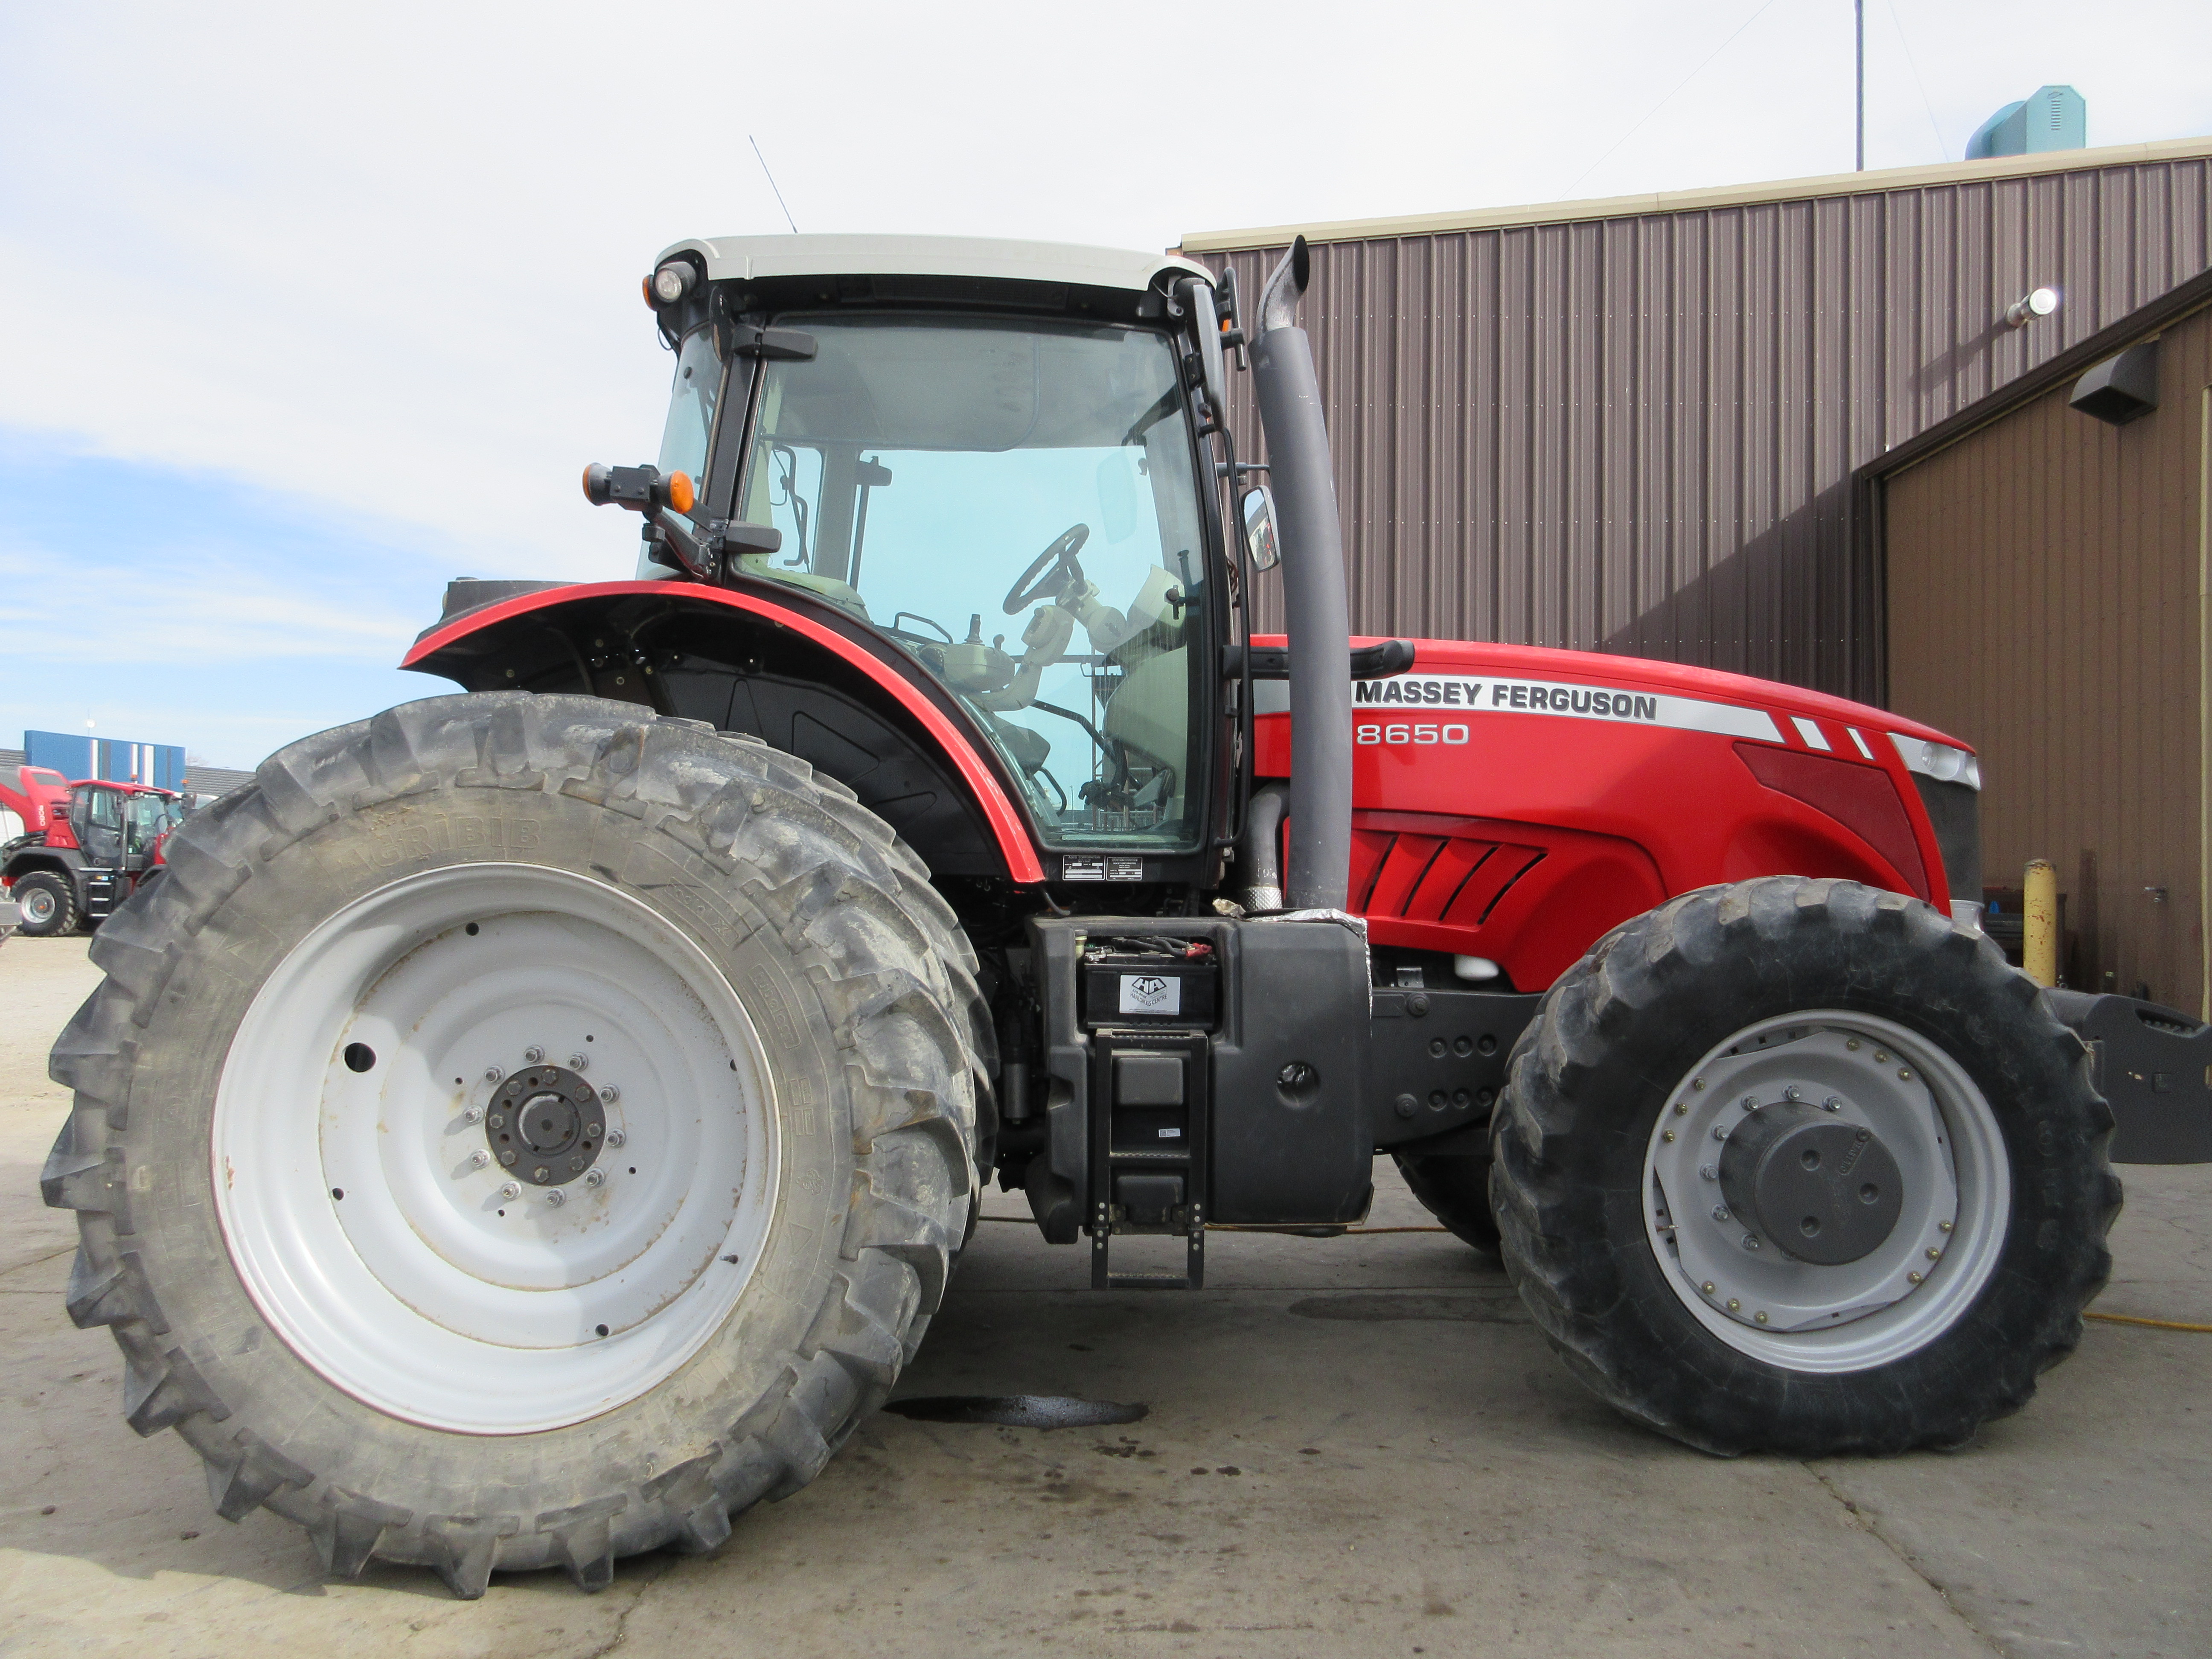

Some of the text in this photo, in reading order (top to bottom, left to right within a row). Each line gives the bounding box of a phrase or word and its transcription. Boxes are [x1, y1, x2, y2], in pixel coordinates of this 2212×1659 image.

[1355, 681, 1657, 720] MASSEY FERGUSON
[1356, 724, 1470, 745] 8650
[1133, 978, 1165, 994] HA
[1130, 992, 1145, 1004] HANLON
[1152, 994, 1167, 1005] CENTRE
